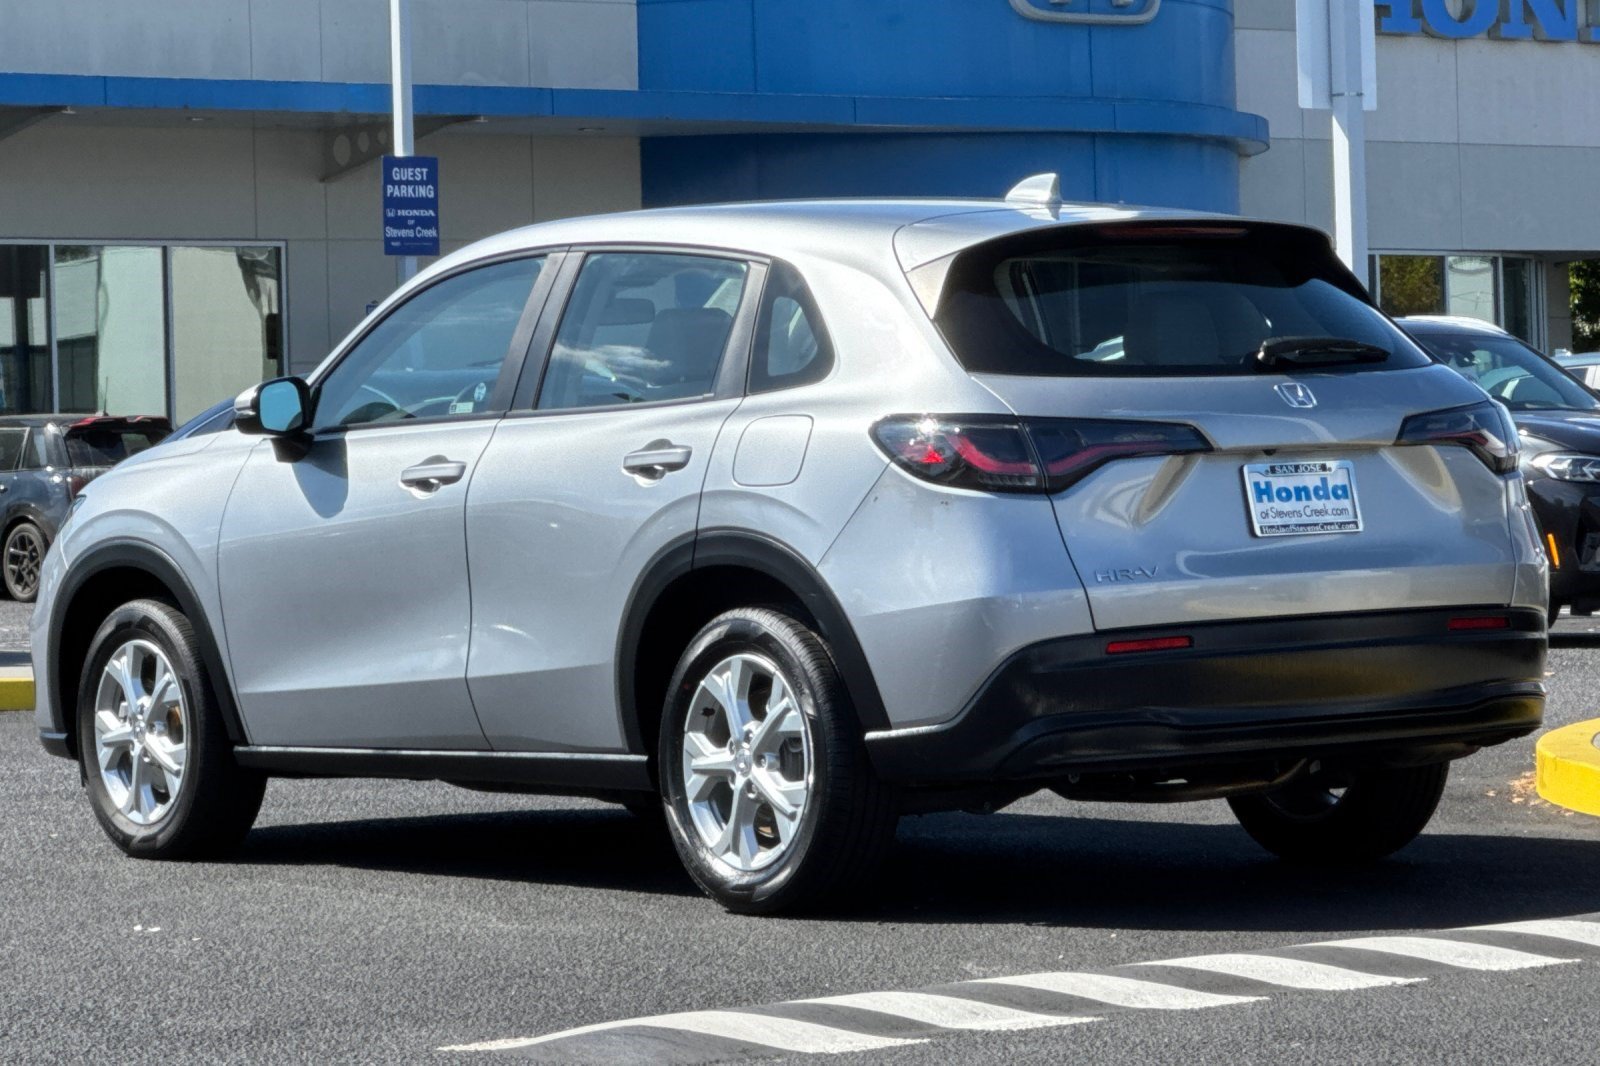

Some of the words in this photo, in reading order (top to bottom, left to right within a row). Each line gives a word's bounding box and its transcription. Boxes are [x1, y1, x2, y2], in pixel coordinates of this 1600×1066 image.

[392, 167, 429, 181] GUEST
[387, 185, 435, 198] PARKING
[397, 209, 436, 217] HONDA
[385, 226, 415, 238] Stevens
[415, 226, 438, 238] Creek
[1275, 465, 1295, 474] SAN
[1297, 464, 1323, 473] JOSE
[1253, 477, 1349, 503] Honda
[1260, 509, 1270, 520] of
[1270, 506, 1303, 520] Stevens
[1095, 565, 1159, 583] HR-V
